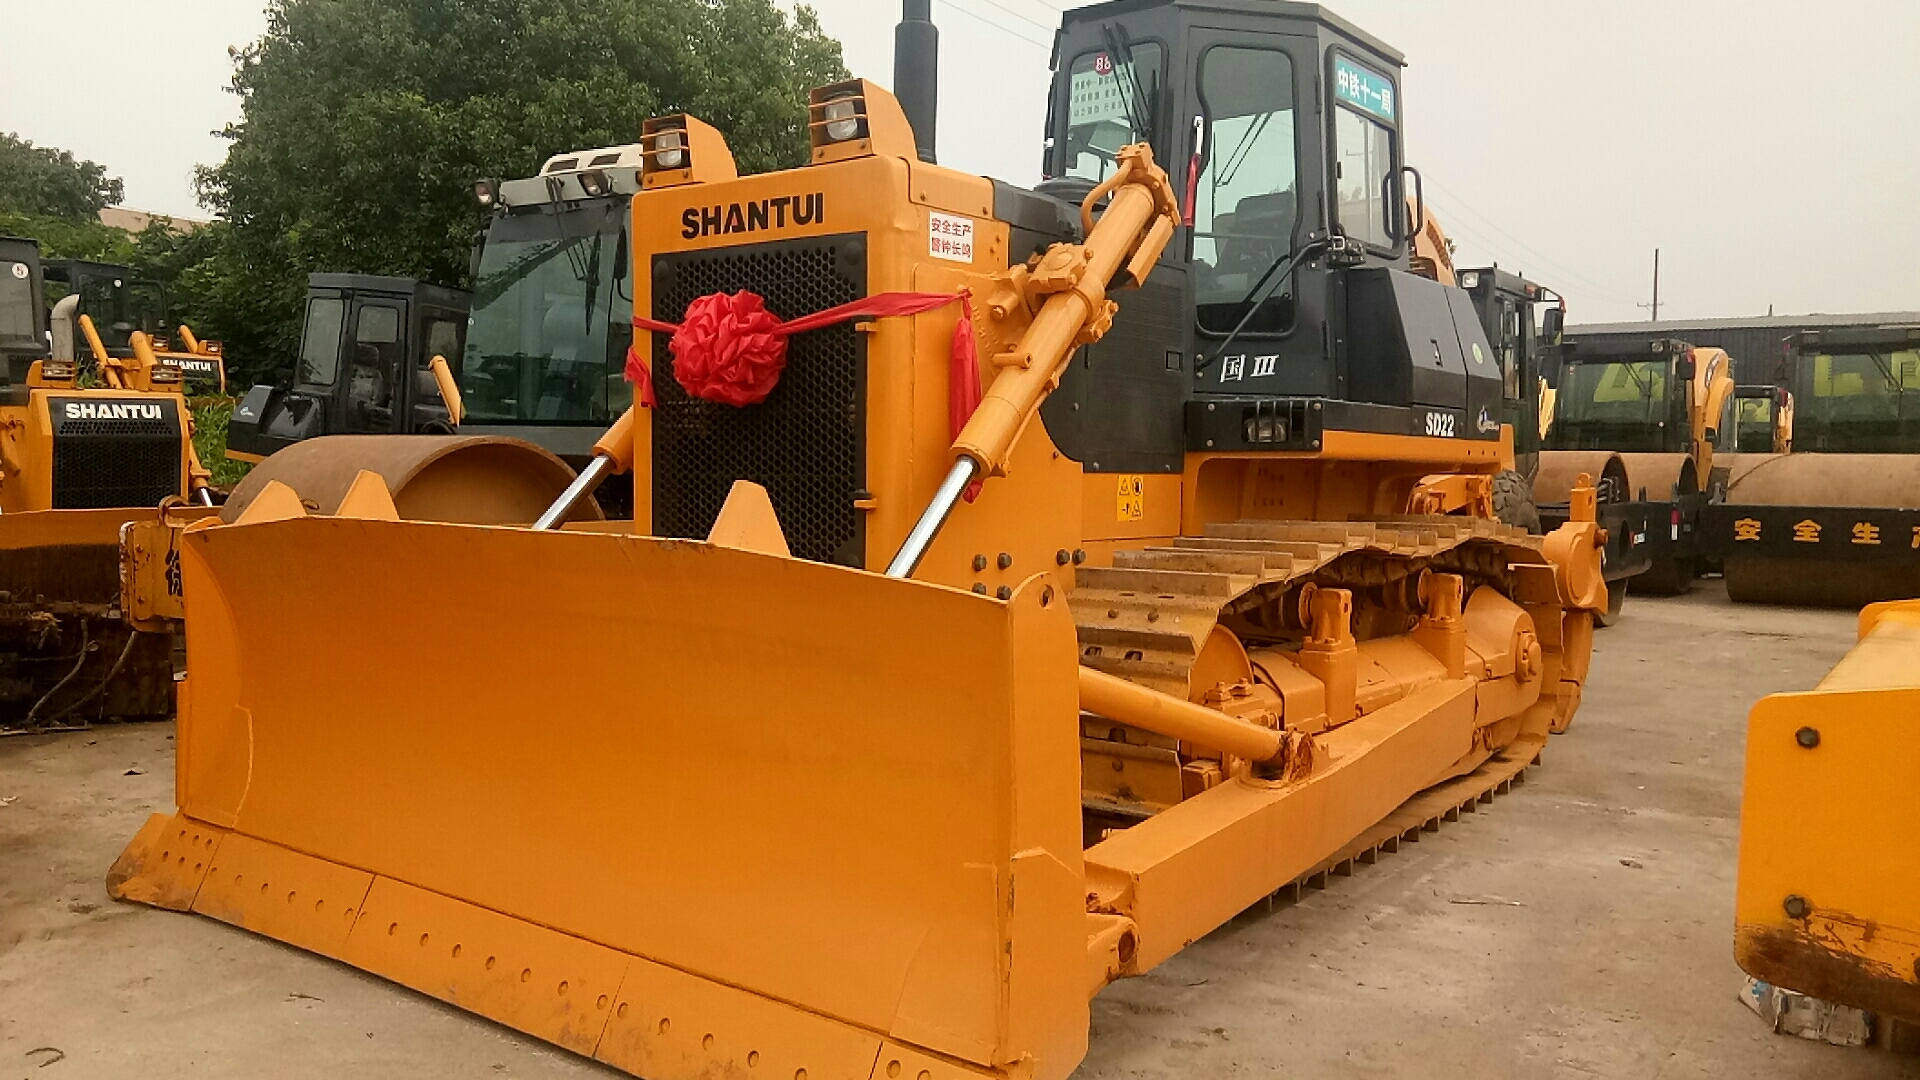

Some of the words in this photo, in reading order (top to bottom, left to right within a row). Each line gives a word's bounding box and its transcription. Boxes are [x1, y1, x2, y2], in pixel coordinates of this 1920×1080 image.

[1338, 66, 1391, 115] 中铁十一局
[681, 192, 824, 239] SHANTUI
[931, 217, 972, 237] 安全生产
[65, 403, 163, 420] SHANTUI
[1425, 411, 1455, 437] SD22
